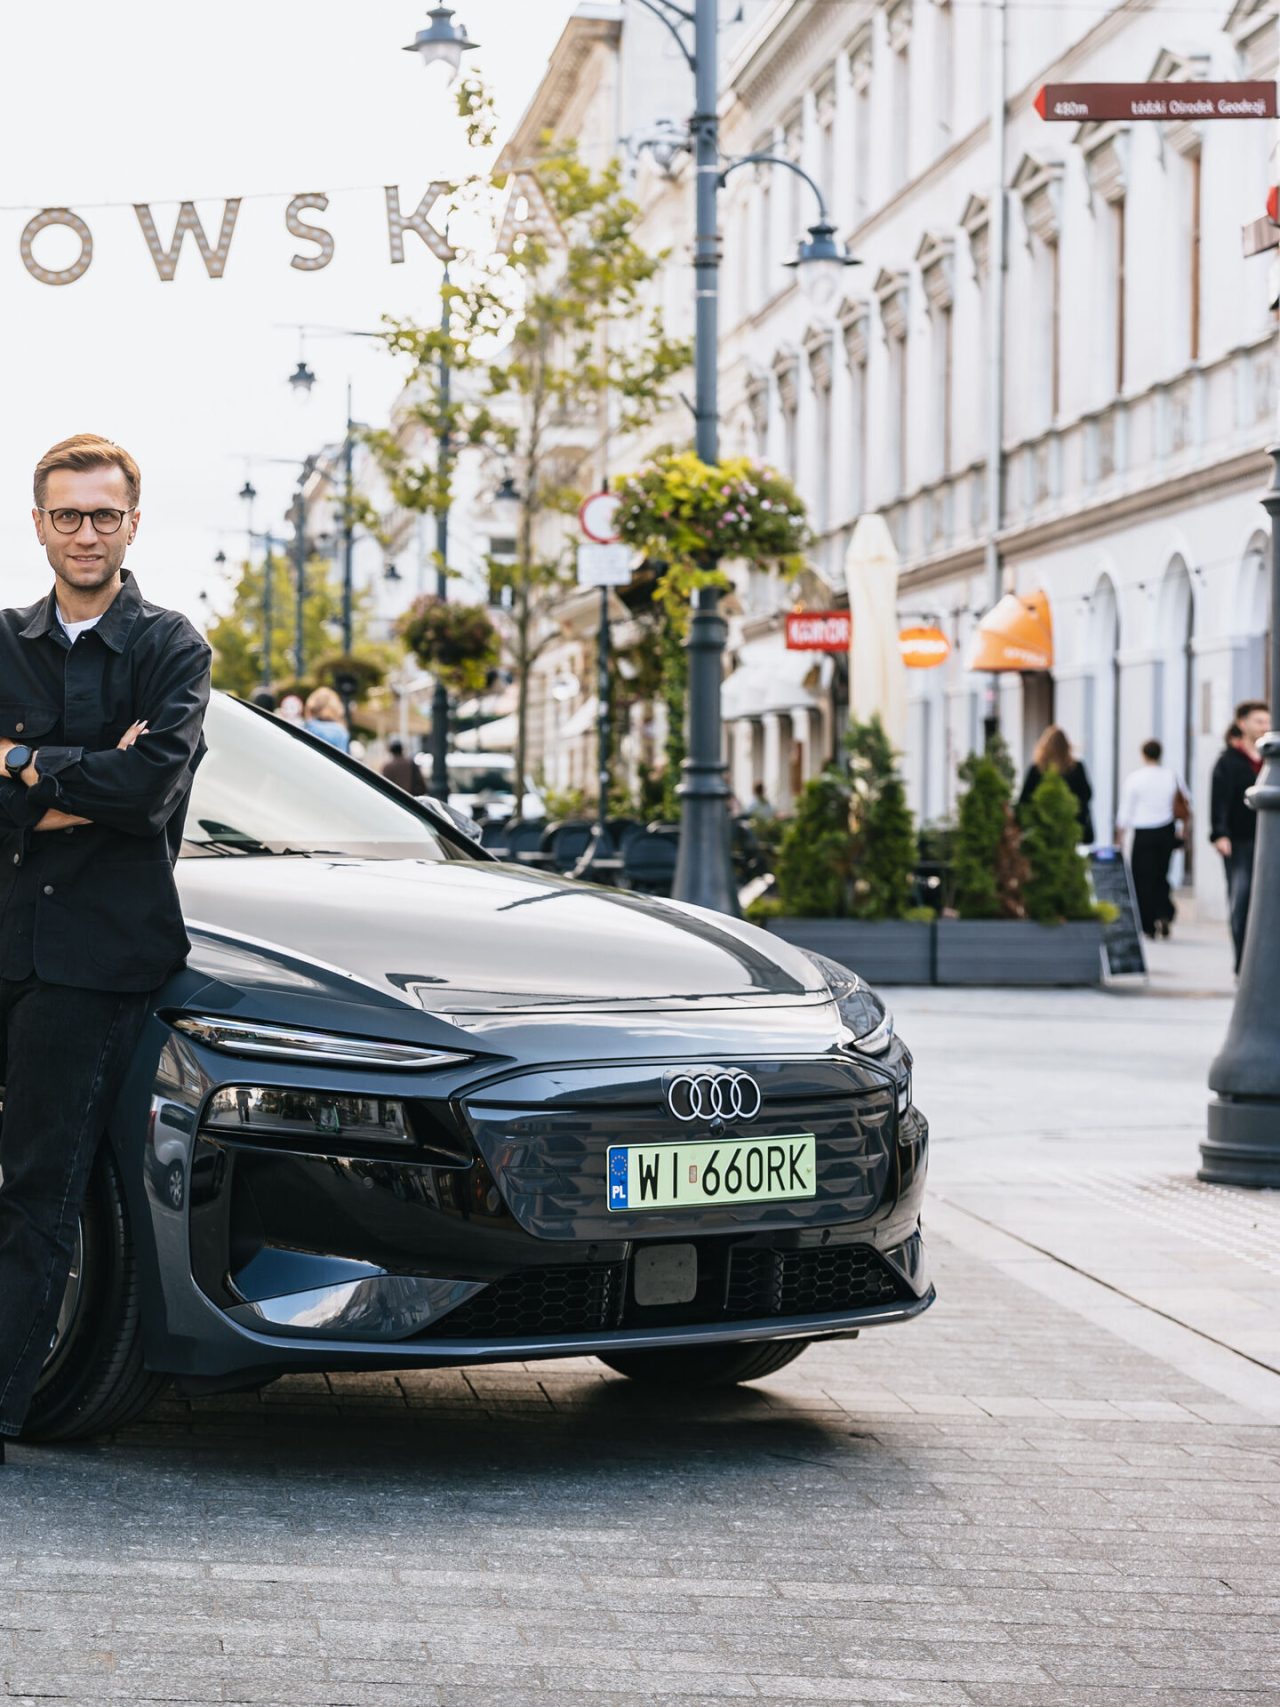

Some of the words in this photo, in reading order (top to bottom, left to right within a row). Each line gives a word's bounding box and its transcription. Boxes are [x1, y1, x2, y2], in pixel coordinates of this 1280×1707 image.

[638, 1152, 678, 1201] WI
[702, 1143, 808, 1196] 660RK
[612, 1185, 627, 1200] PL
